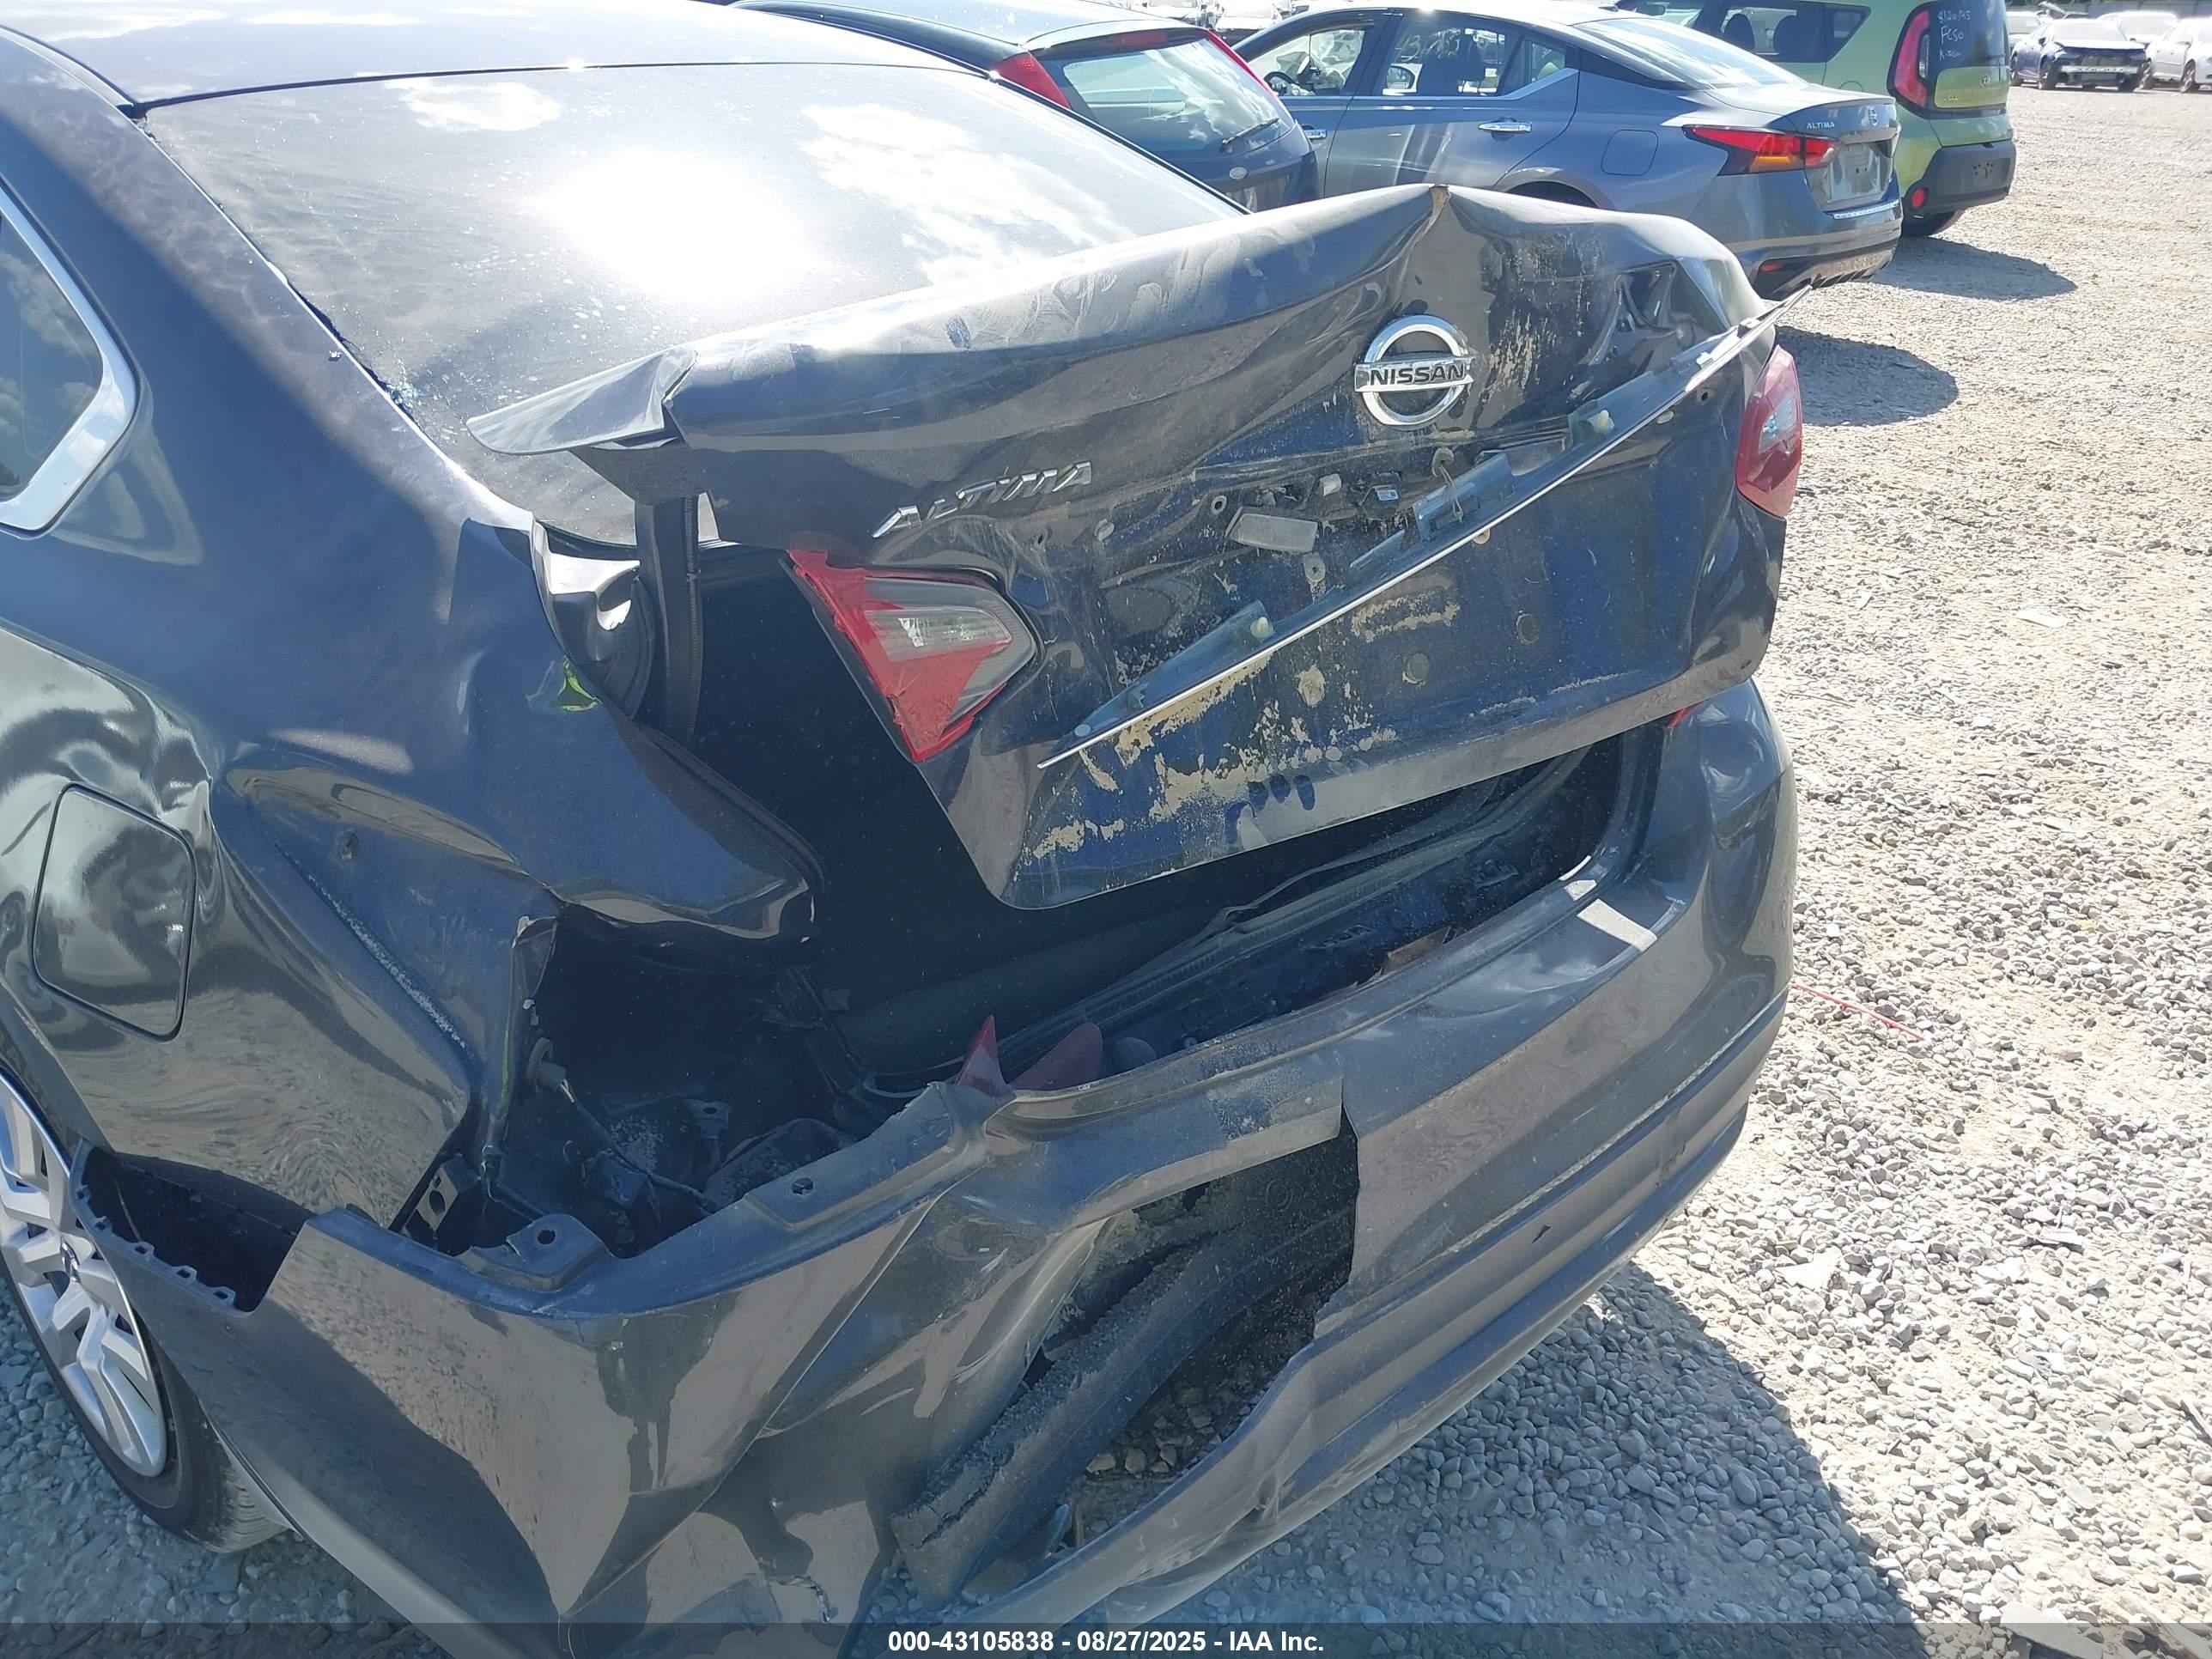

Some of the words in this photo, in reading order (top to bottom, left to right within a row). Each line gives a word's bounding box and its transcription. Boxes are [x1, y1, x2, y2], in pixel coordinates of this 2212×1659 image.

[1806, 121, 1835, 130] ALTIMA
[1370, 363, 1465, 386] NISSAN
[872, 461, 1092, 538] ALTIMA
